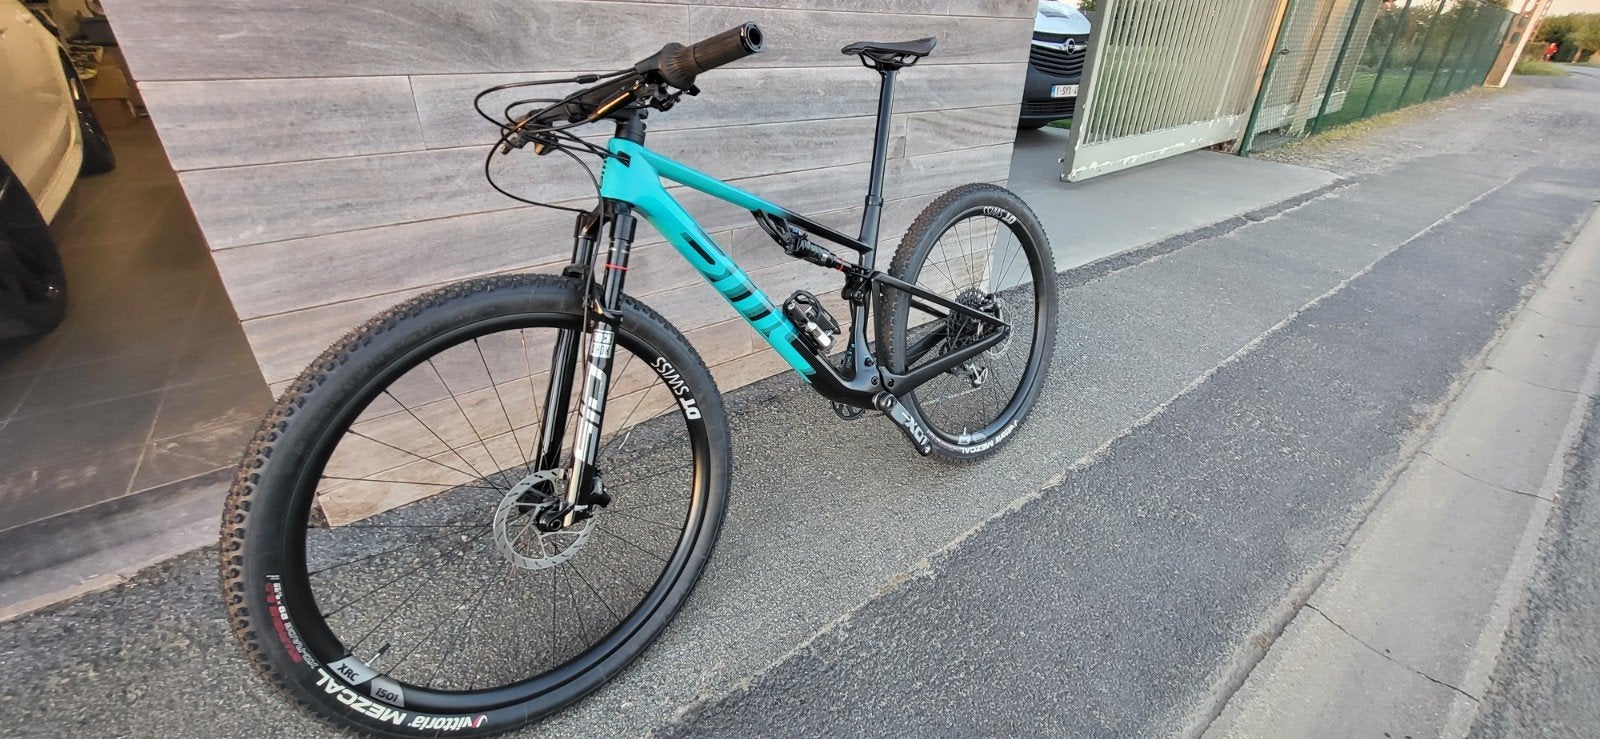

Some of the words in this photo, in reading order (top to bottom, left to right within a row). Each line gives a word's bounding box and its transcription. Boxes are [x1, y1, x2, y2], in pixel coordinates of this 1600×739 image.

[650, 356, 690, 396] SWISS
[679, 397, 702, 420] DT
[958, 440, 994, 454] MEZCAL
[337, 663, 360, 682] XRC
[315, 668, 408, 726] MEZCAL
[375, 687, 400, 703] 1501
